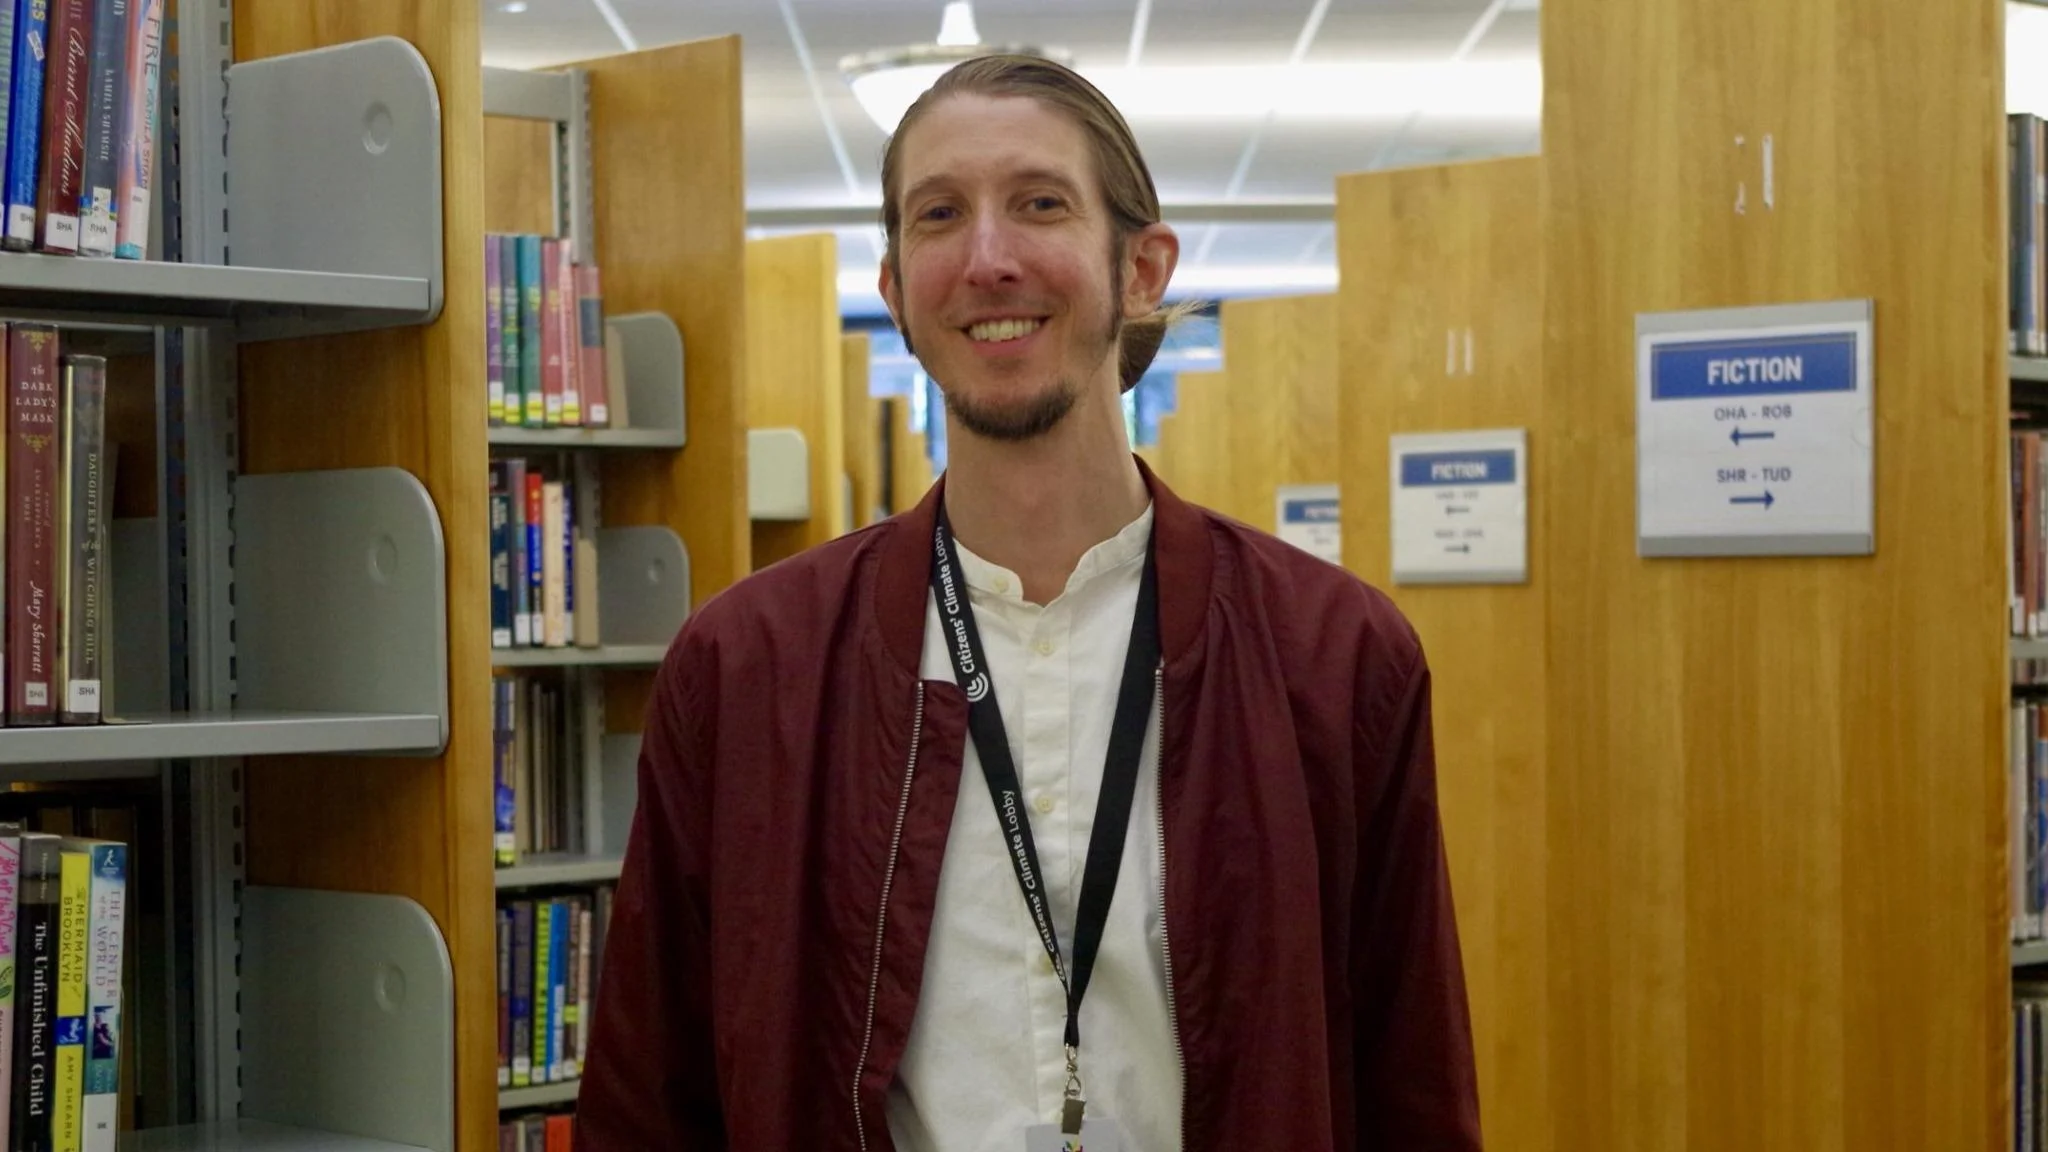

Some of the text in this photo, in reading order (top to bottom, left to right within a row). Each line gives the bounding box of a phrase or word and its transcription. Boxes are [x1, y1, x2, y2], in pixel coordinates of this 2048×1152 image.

[143, 17, 161, 76] FIRE
[60, 26, 86, 197] Burnt Shadows
[56, 220, 73, 232] SHA
[20, 381, 53, 392] DARK
[1707, 356, 1802, 385] FICTION
[15, 396, 57, 408] LADY'S
[20, 412, 54, 424] MASK
[1761, 404, 1792, 419] ROB
[87, 452, 97, 534] DAUGHTERS
[1430, 461, 1488, 481] FICTION
[1716, 468, 1747, 483] SHR
[1761, 466, 1792, 482] TUD
[27, 580, 45, 619] Mary
[85, 556, 97, 628] WITCHING
[938, 563, 960, 615] Climate
[85, 632, 95, 665] HILL
[949, 617, 976, 674] Citizens'
[78, 687, 96, 696] SHA
[1002, 789, 1020, 833] Lobby
[1012, 833, 1037, 890] Climate
[110, 889, 121, 922] THE
[61, 896, 74, 983] BROOKLYN
[73, 902, 86, 985] MERMAID
[94, 925, 108, 987] WORLD
[106, 931, 119, 999] CENTER
[29, 921, 49, 1116] The Unfinished Child
[63, 1054, 75, 1140] AMY SHEARN
